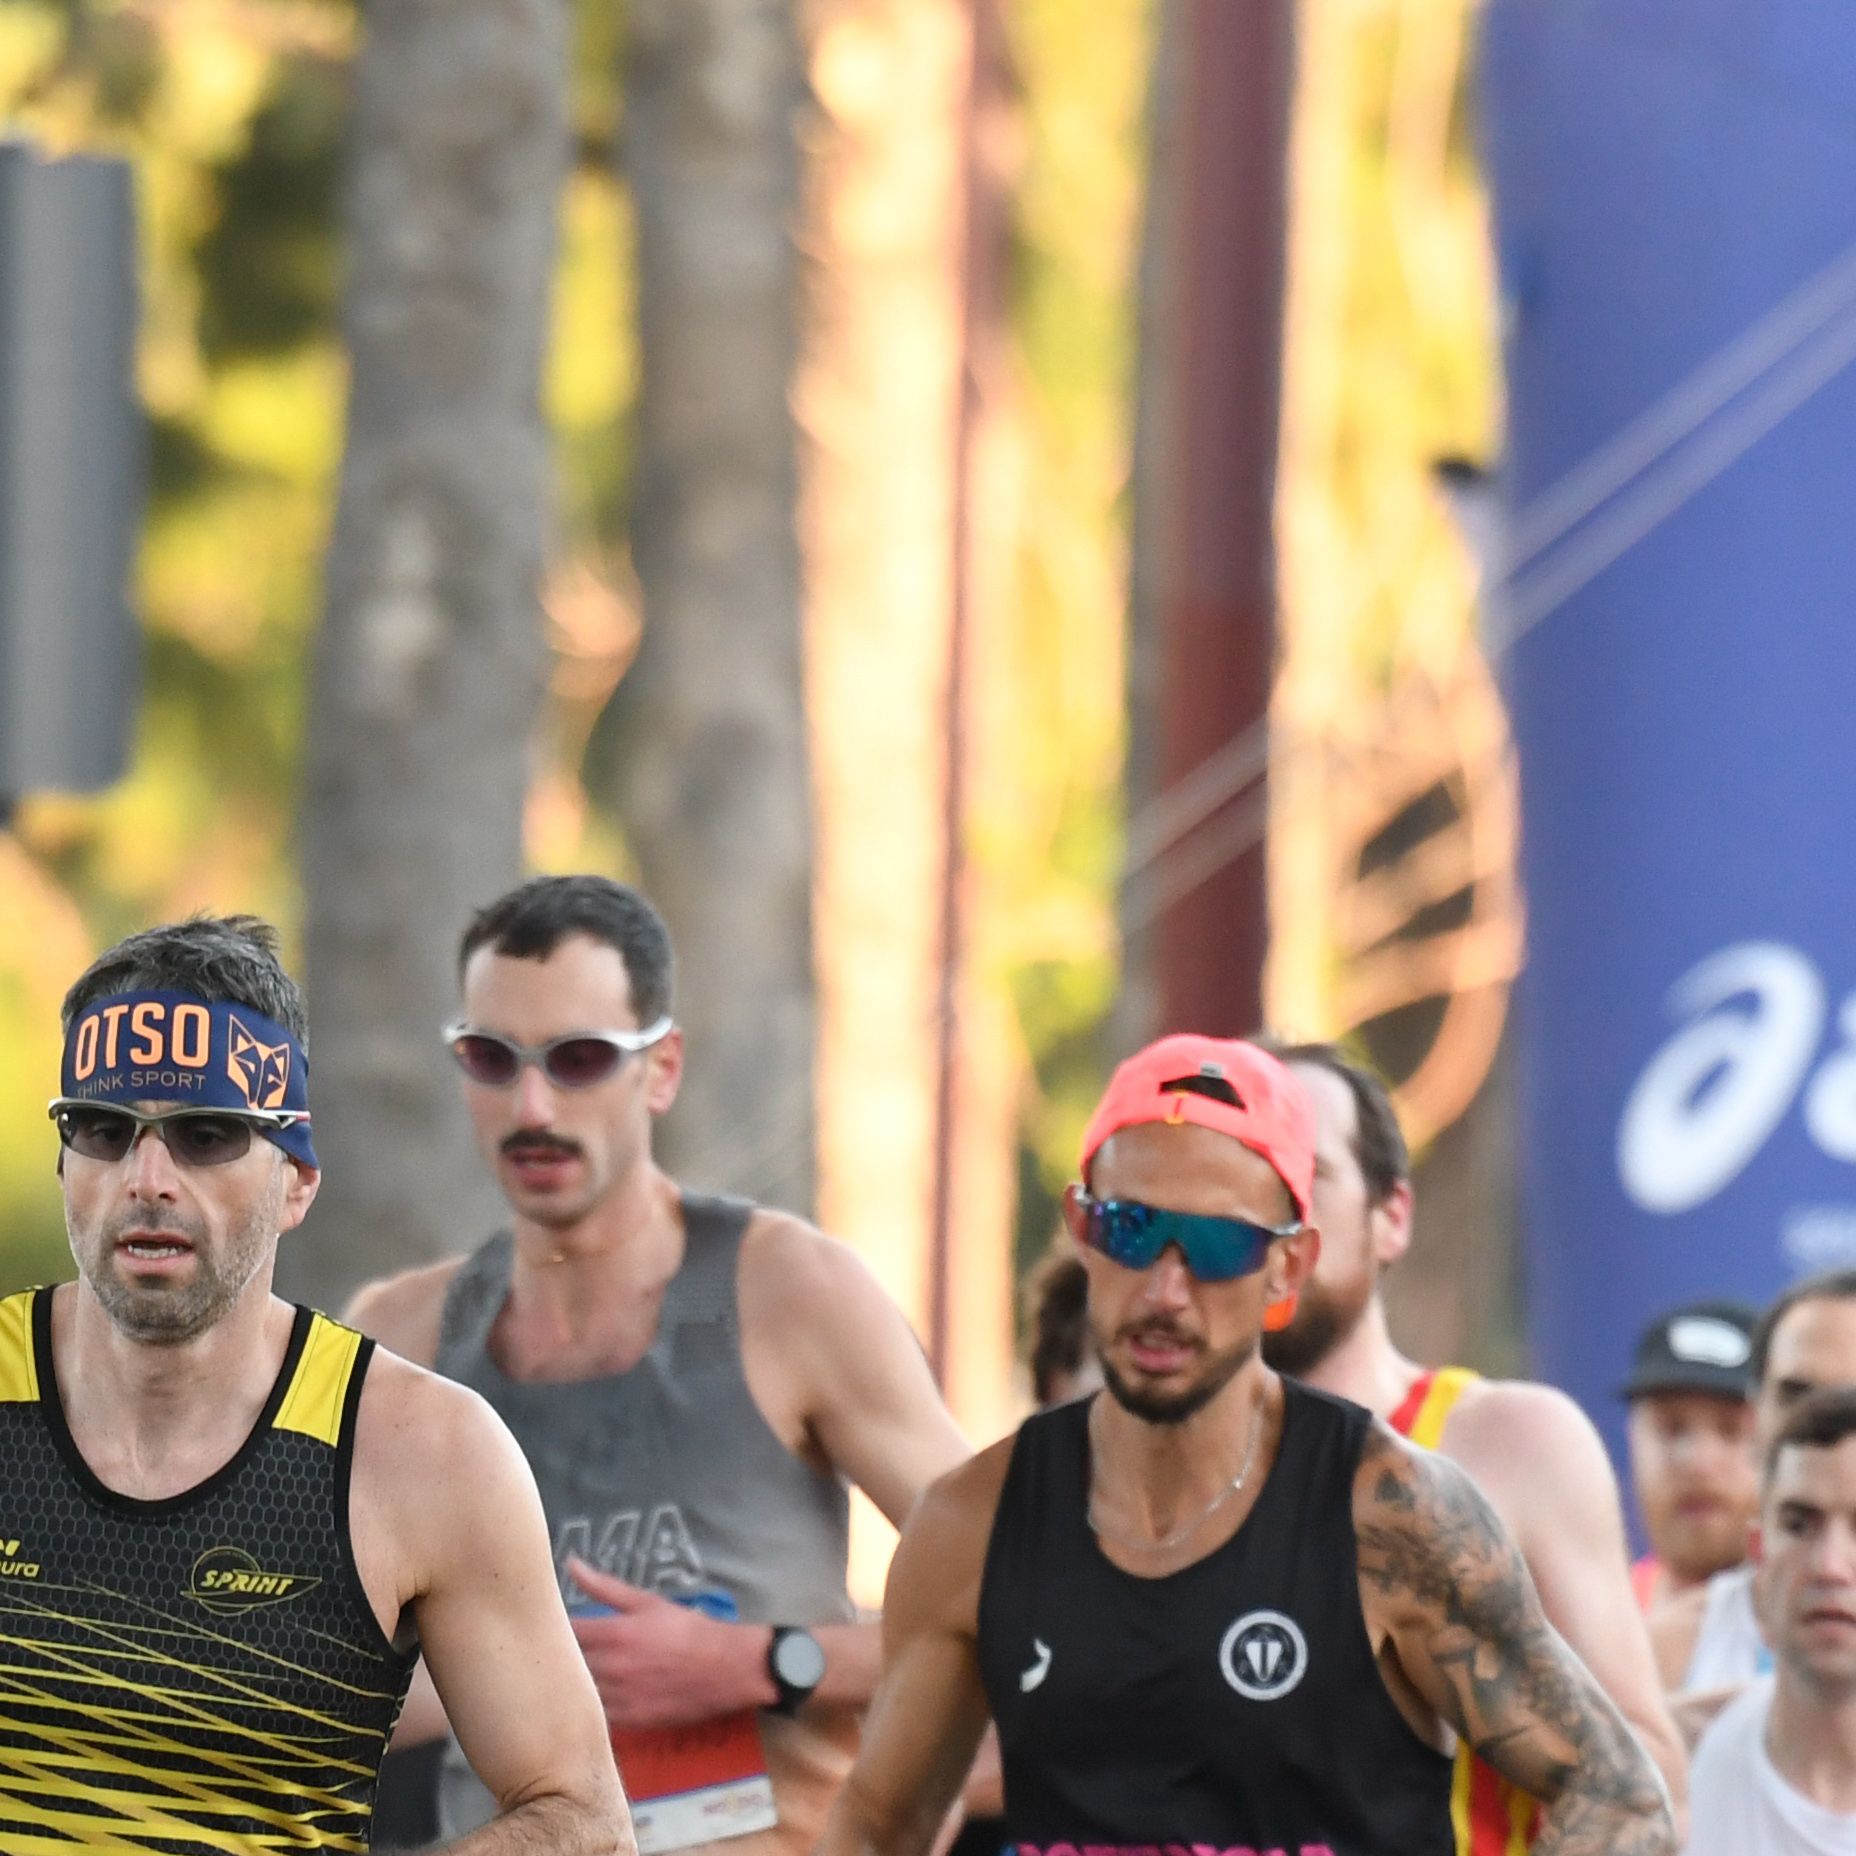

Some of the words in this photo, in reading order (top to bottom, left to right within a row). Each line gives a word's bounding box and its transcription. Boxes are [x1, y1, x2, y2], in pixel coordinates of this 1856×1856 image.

[75, 1002, 210, 1081] OTSO
[77, 1073, 124, 1098] THINK
[131, 1071, 206, 1090] SPORT
[200, 1569, 294, 1595] SPRINT
